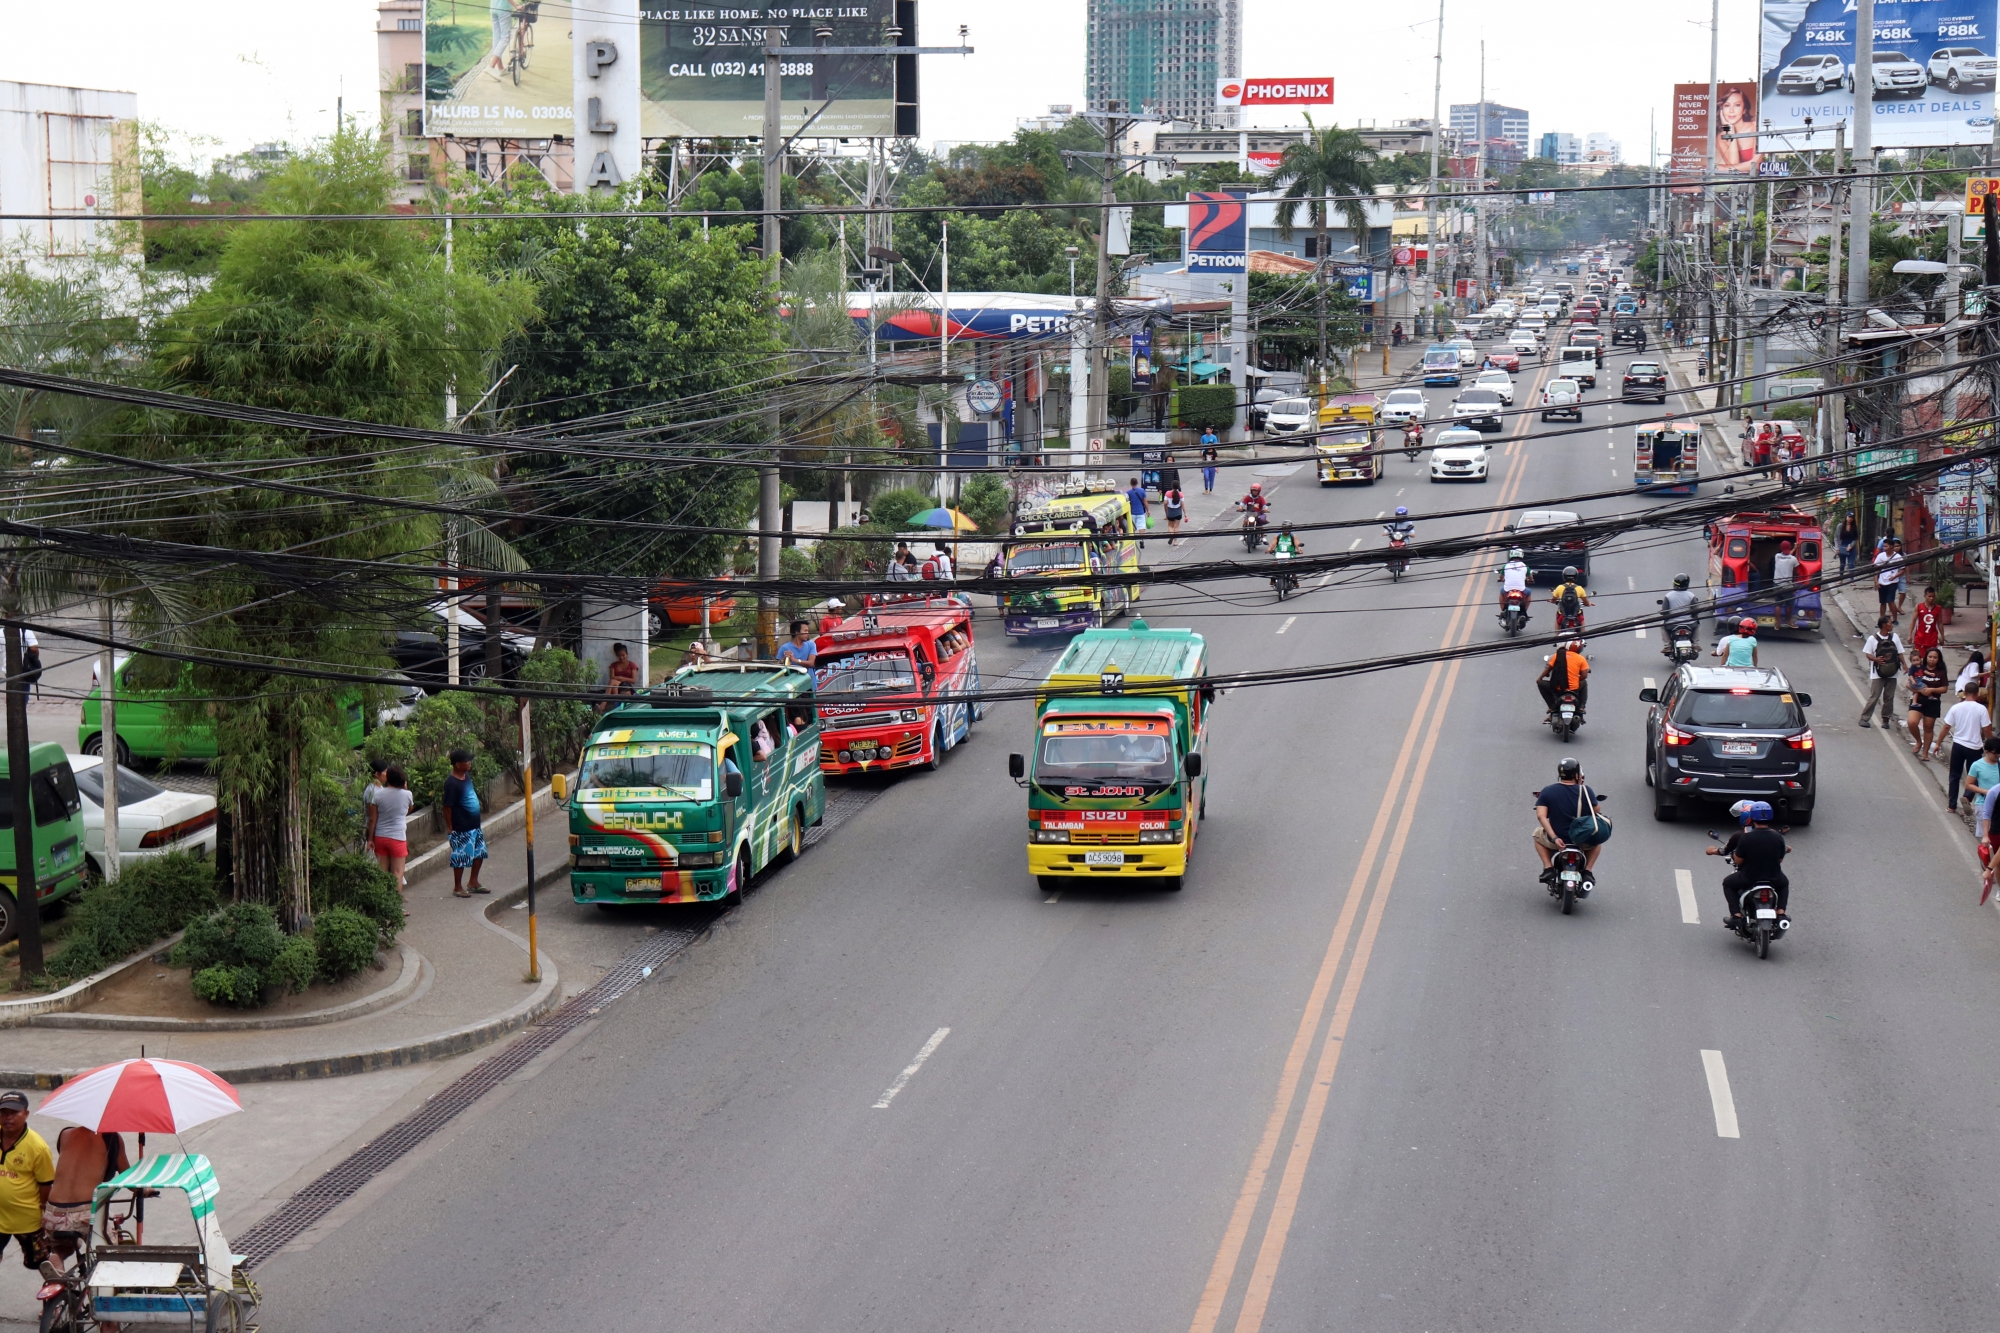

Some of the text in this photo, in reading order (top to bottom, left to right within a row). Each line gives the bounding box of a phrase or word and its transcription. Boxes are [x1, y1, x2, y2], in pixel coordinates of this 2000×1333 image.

[640, 8, 868, 20] PLACE LIKE HOME. NO PLACE LIKE
[692, 26, 716, 46] 32
[668, 64, 706, 76] CALL
[711, 62, 746, 77] (032)
[1247, 84, 1329, 98] PHOENIX
[432, 105, 575, 119] HLURB LS No. 03036
[1874, 102, 1927, 115] GREAT
[1930, 100, 1982, 113] DEALS
[1970, 117, 1992, 126] Ford
[1760, 162, 1789, 172] GLOBAL
[1188, 254, 1245, 268] PETRON
[1338, 266, 1368, 276] wash
[1348, 286, 1368, 298] dry
[1020, 510, 1083, 522] CHICKS CARRIER
[1923, 614, 1934, 625] G
[1925, 625, 1931, 633] 7
[598, 745, 700, 757] God is Good
[592, 789, 696, 798] all the time
[603, 811, 683, 830] SETOUCHI
[1081, 811, 1127, 820] ISUZU
[1044, 822, 1084, 830] TALAMBAN
[1088, 854, 1122, 863] ACS 9098
